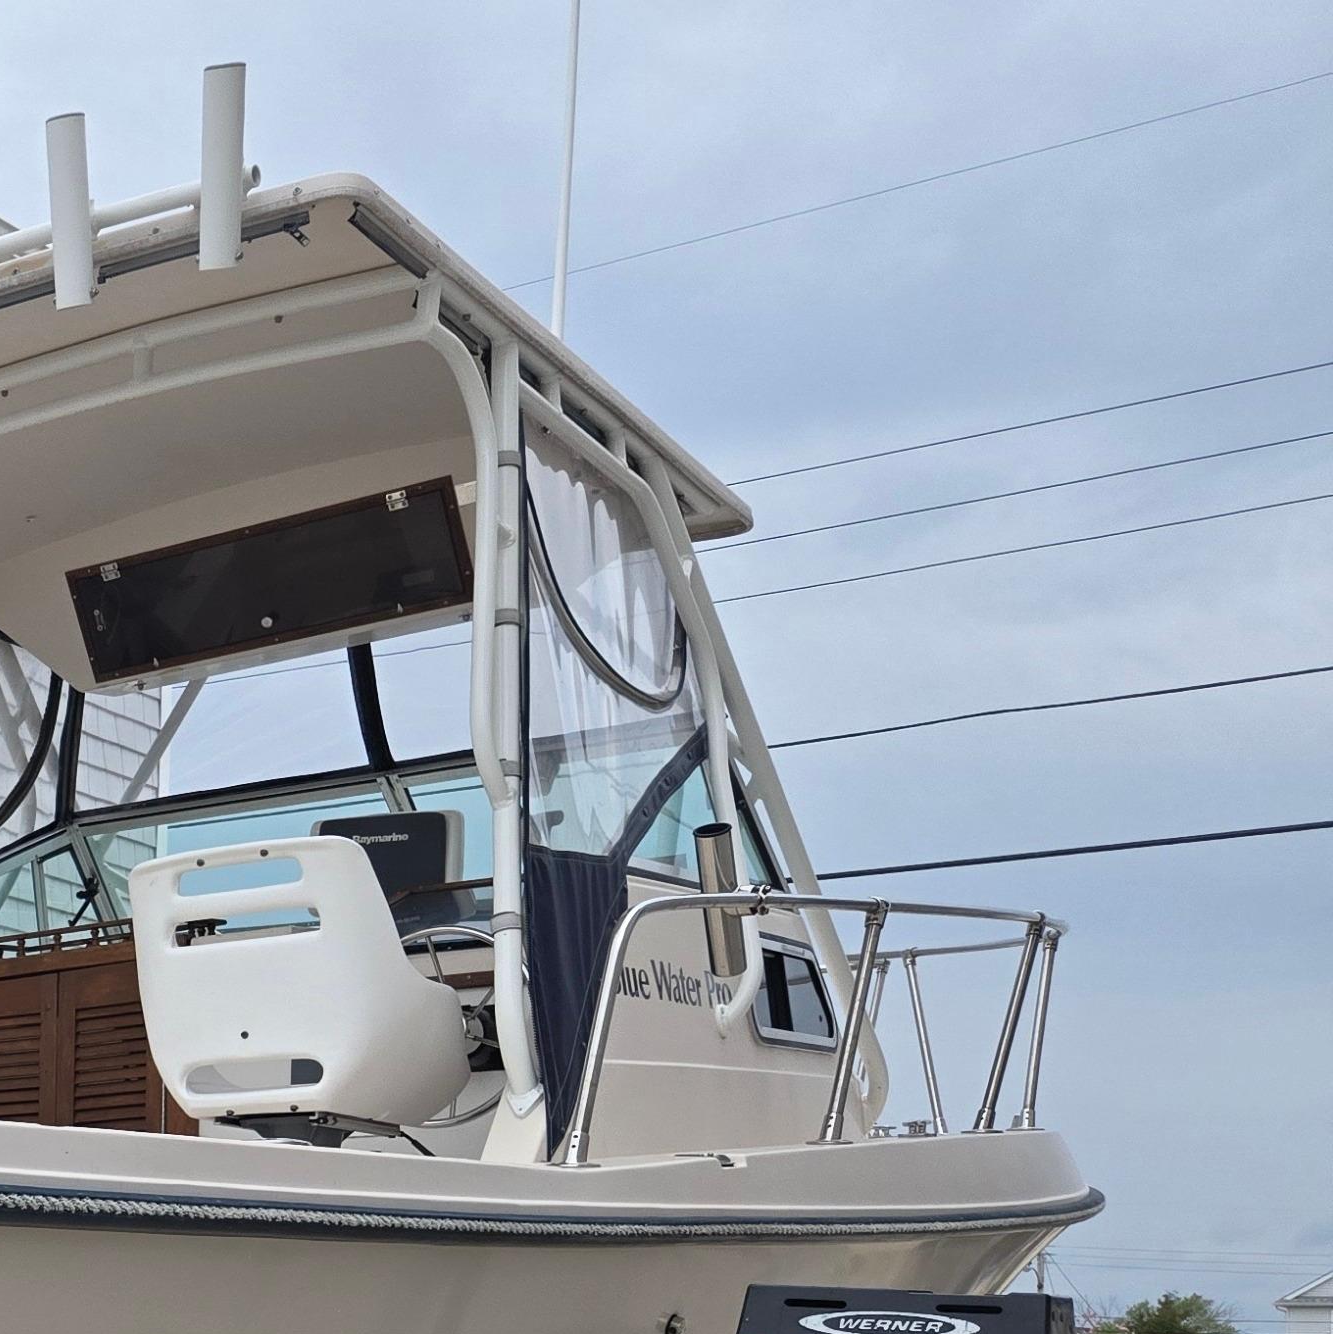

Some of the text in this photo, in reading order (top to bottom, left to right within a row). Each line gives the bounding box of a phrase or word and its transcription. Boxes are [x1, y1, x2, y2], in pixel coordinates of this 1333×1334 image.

[617, 966, 651, 1000] lue
[650, 959, 701, 1007] Water
[838, 1317, 944, 1333] WERNER
